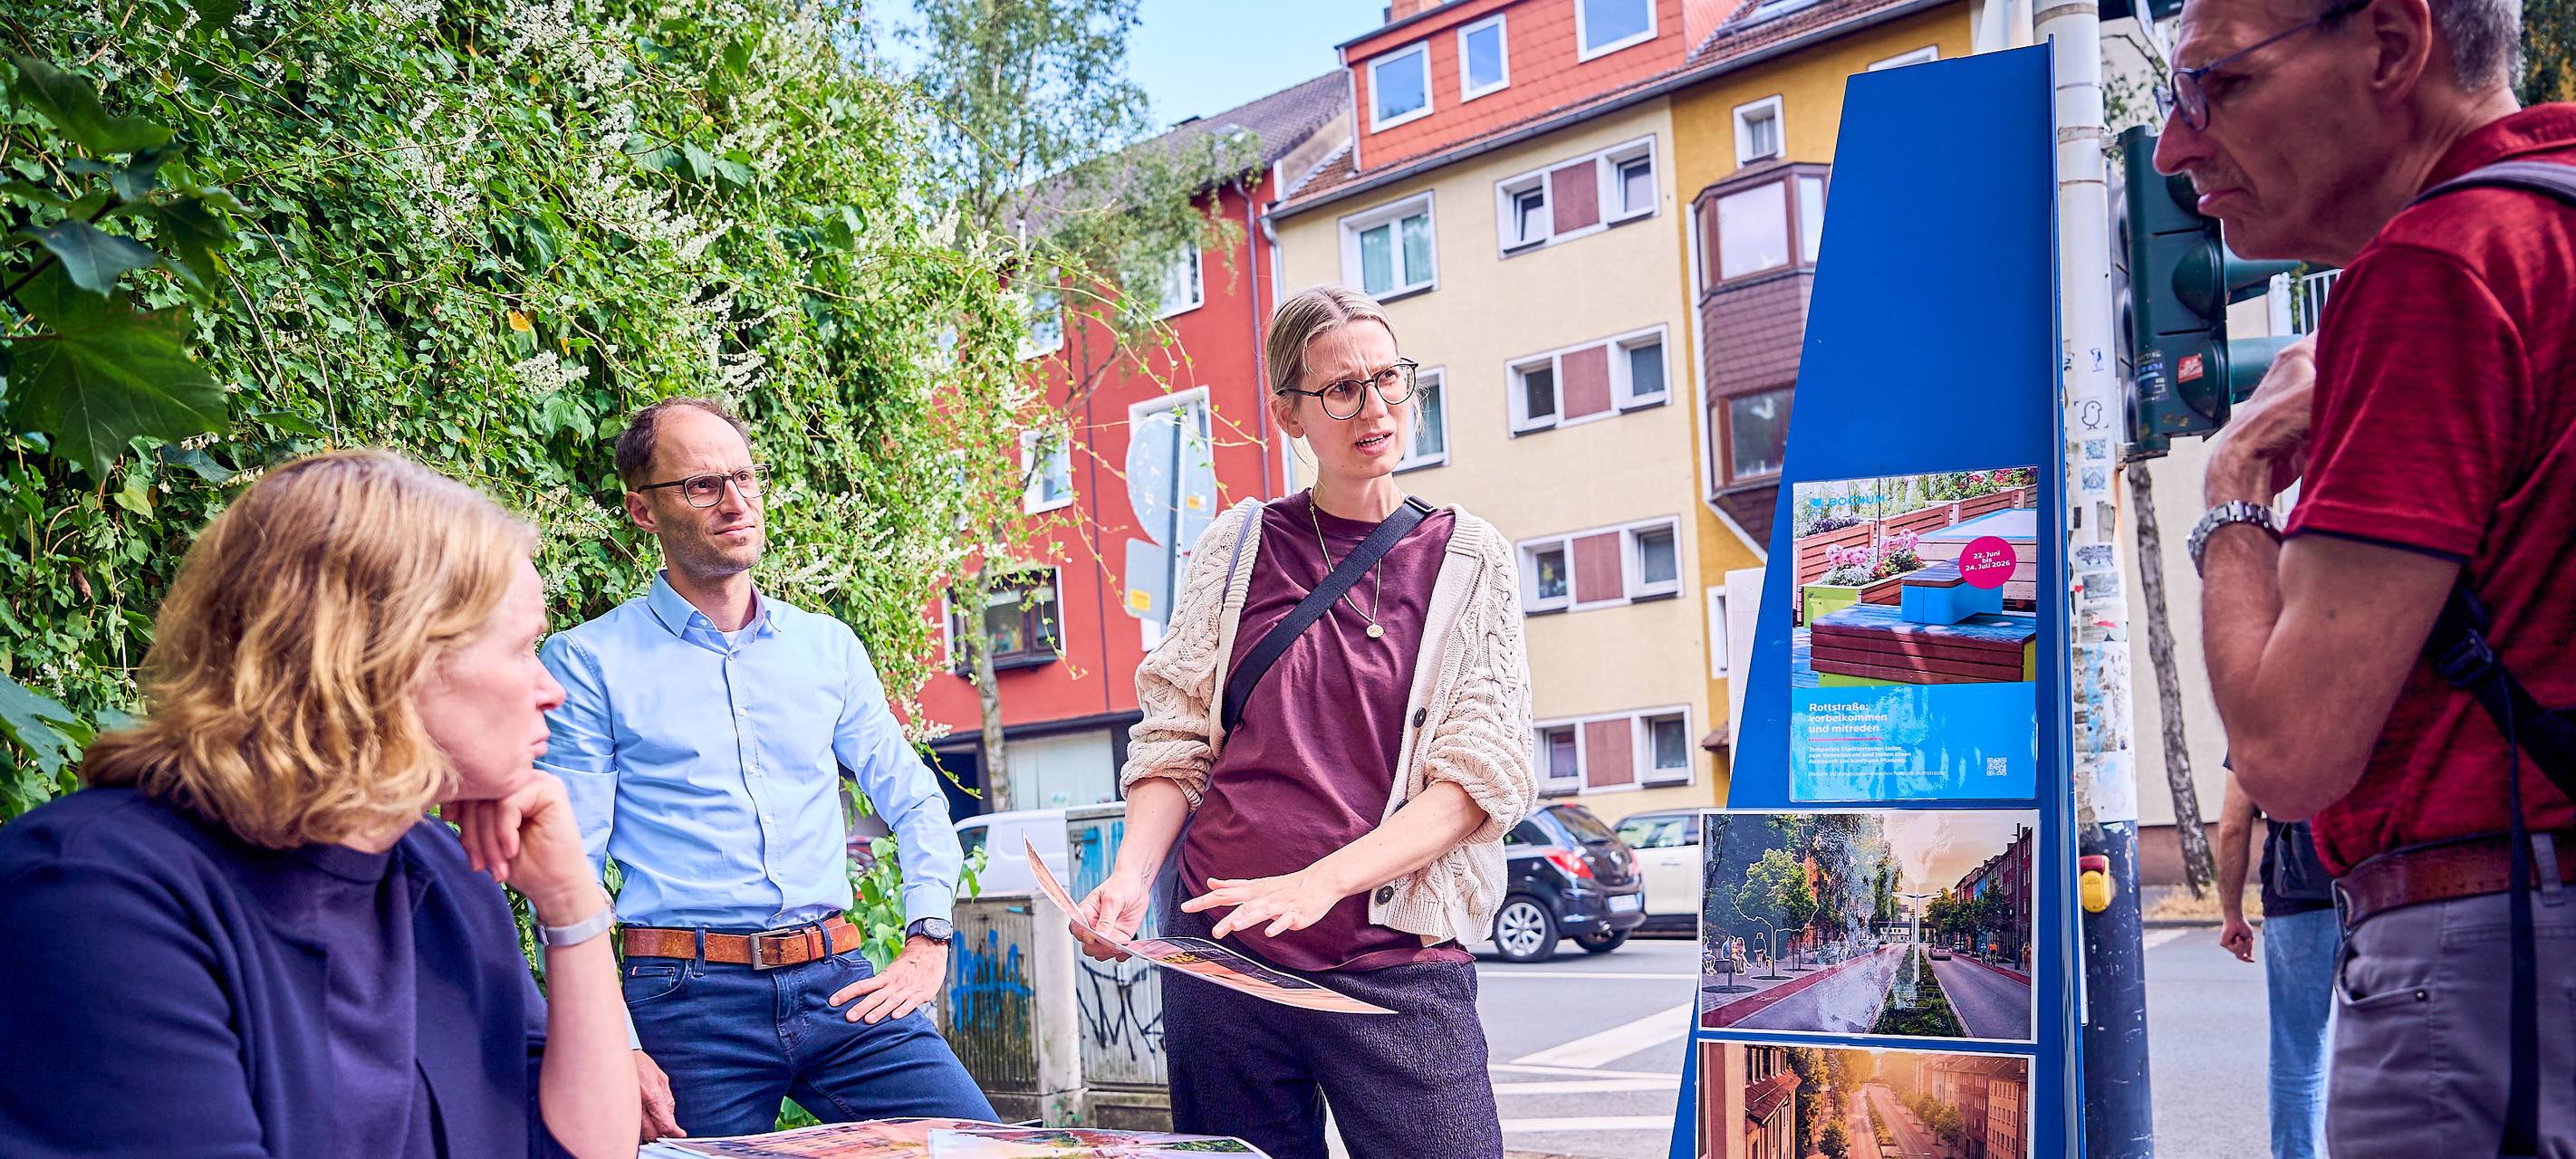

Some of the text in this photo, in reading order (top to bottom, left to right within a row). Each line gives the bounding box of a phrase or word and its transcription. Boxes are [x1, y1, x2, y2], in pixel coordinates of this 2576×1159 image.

[1829, 493, 1885, 507] BOCHUM
[1992, 560, 2011, 568] 2026
[1809, 702, 1870, 712] Rottstraße:
[1808, 714, 1888, 723] vorbeikommen
[1809, 723, 1879, 733] und mitreden
